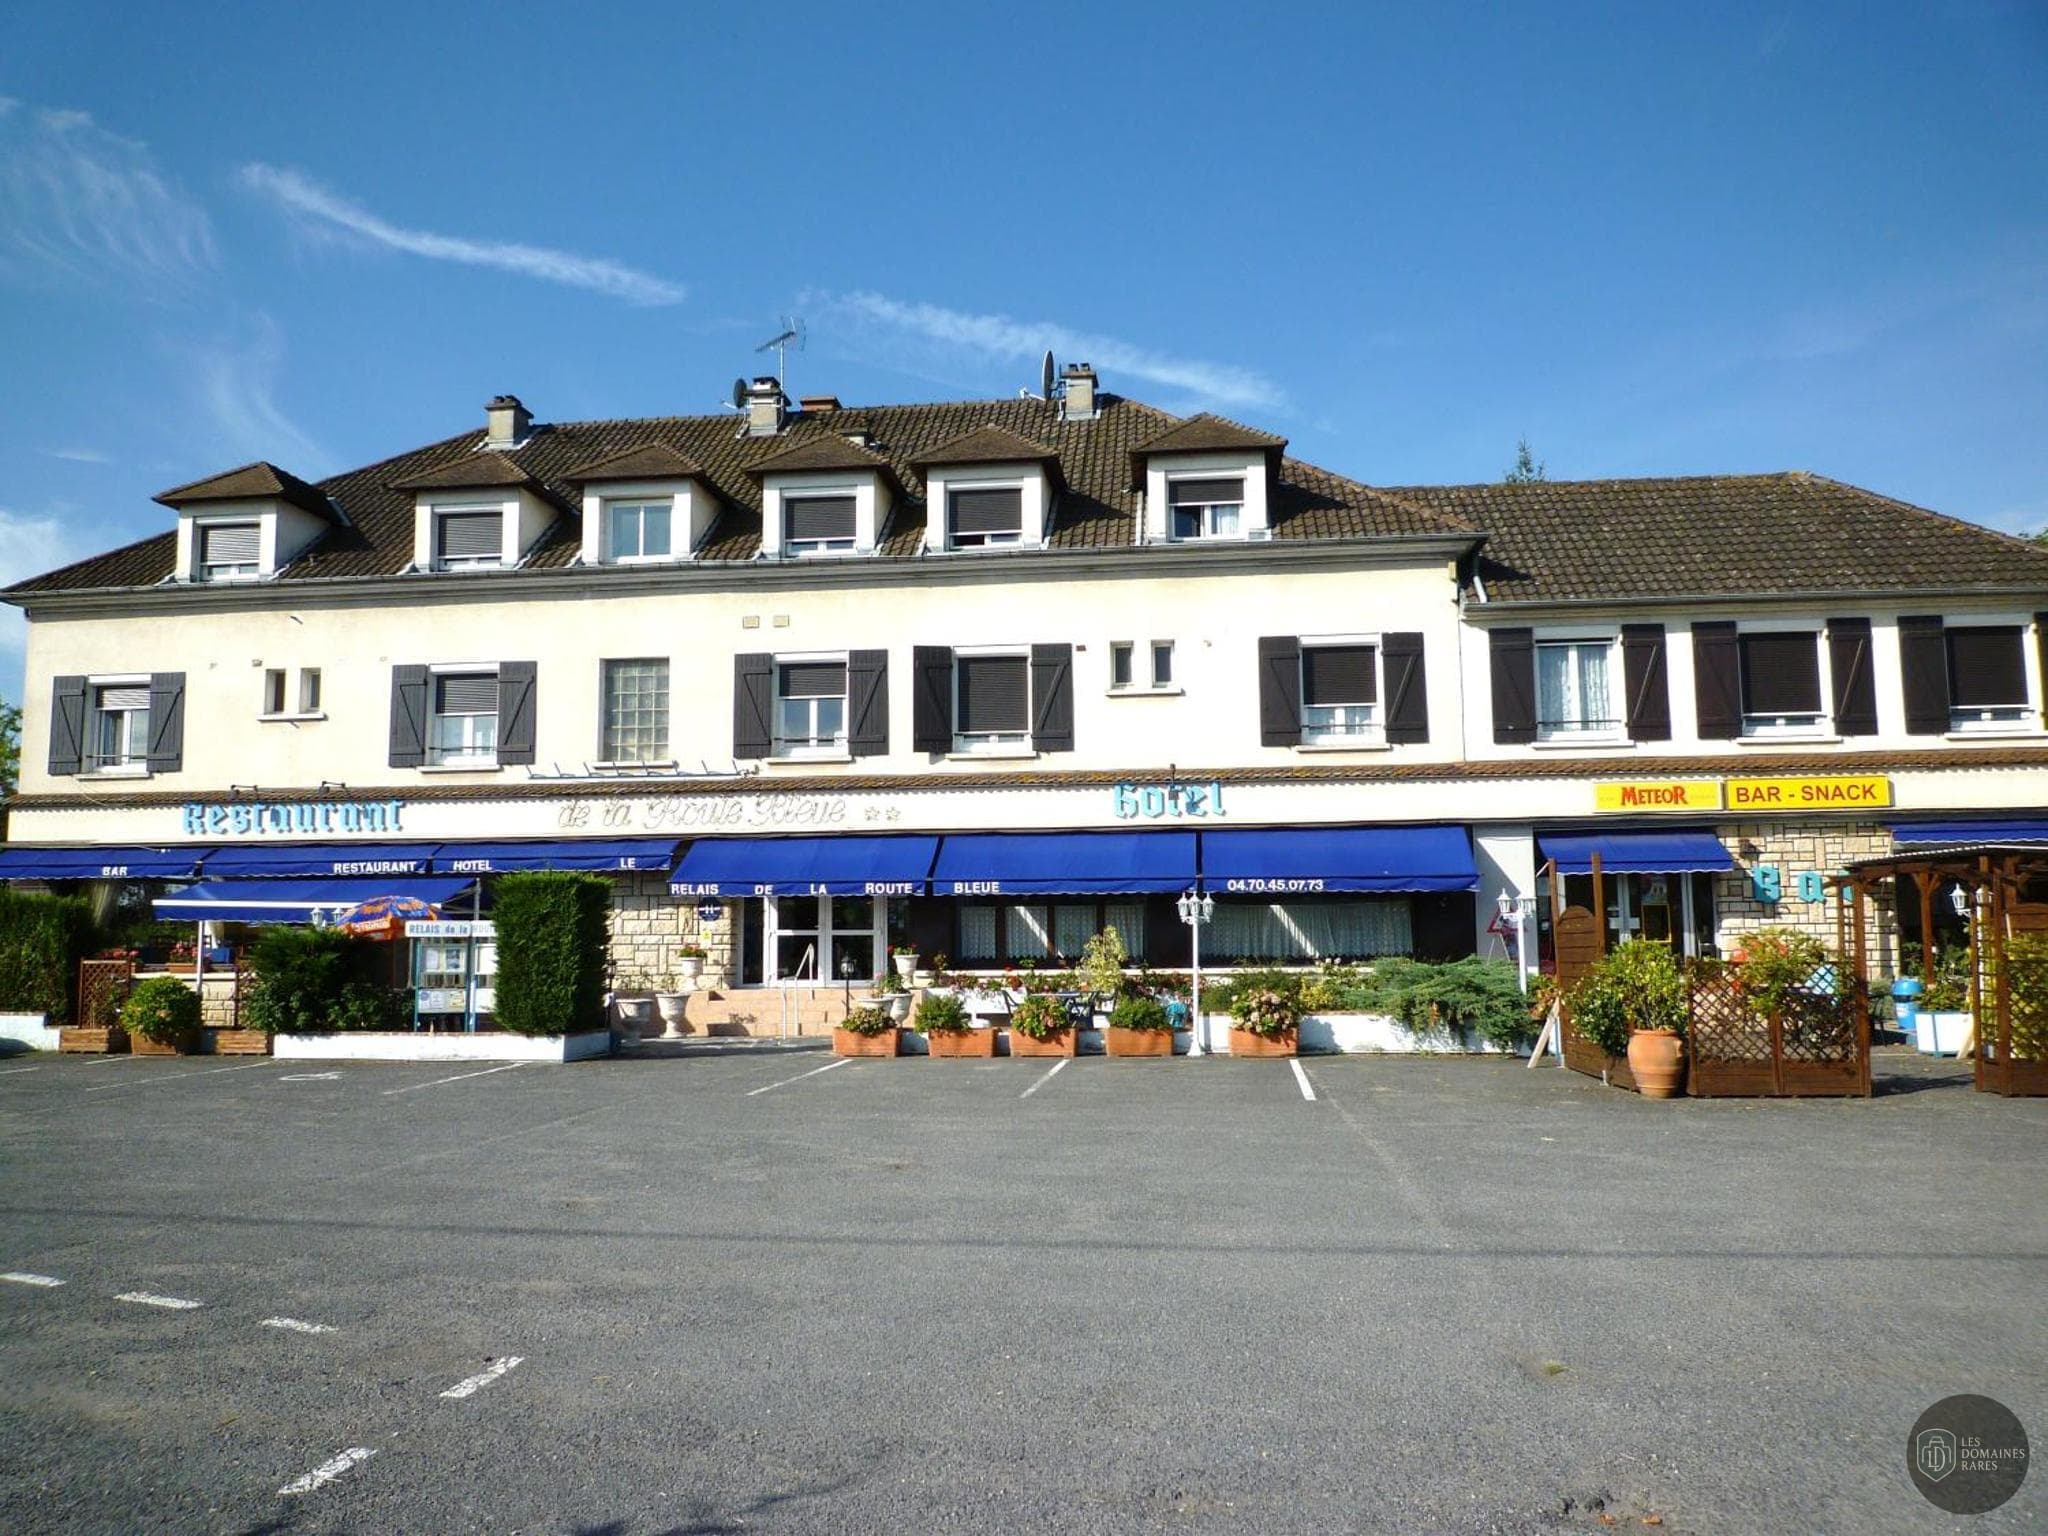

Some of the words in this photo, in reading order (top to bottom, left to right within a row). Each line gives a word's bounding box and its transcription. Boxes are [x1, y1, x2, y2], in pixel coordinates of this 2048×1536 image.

[1736, 785, 1781, 802] BAR
[1801, 784, 1877, 800] SNACK
[182, 800, 407, 835] Restaurant
[102, 866, 128, 876] BAR
[333, 861, 417, 874] RESTAURANT
[453, 860, 493, 871] HOTEL
[620, 858, 636, 868] LE
[671, 884, 719, 895] RELAIS
[755, 884, 773, 895] DE
[810, 883, 827, 894] LA
[865, 883, 913, 893] ROUTE
[954, 881, 1000, 894] BLEUE
[1227, 879, 1324, 891] 04.70.45.07.73
